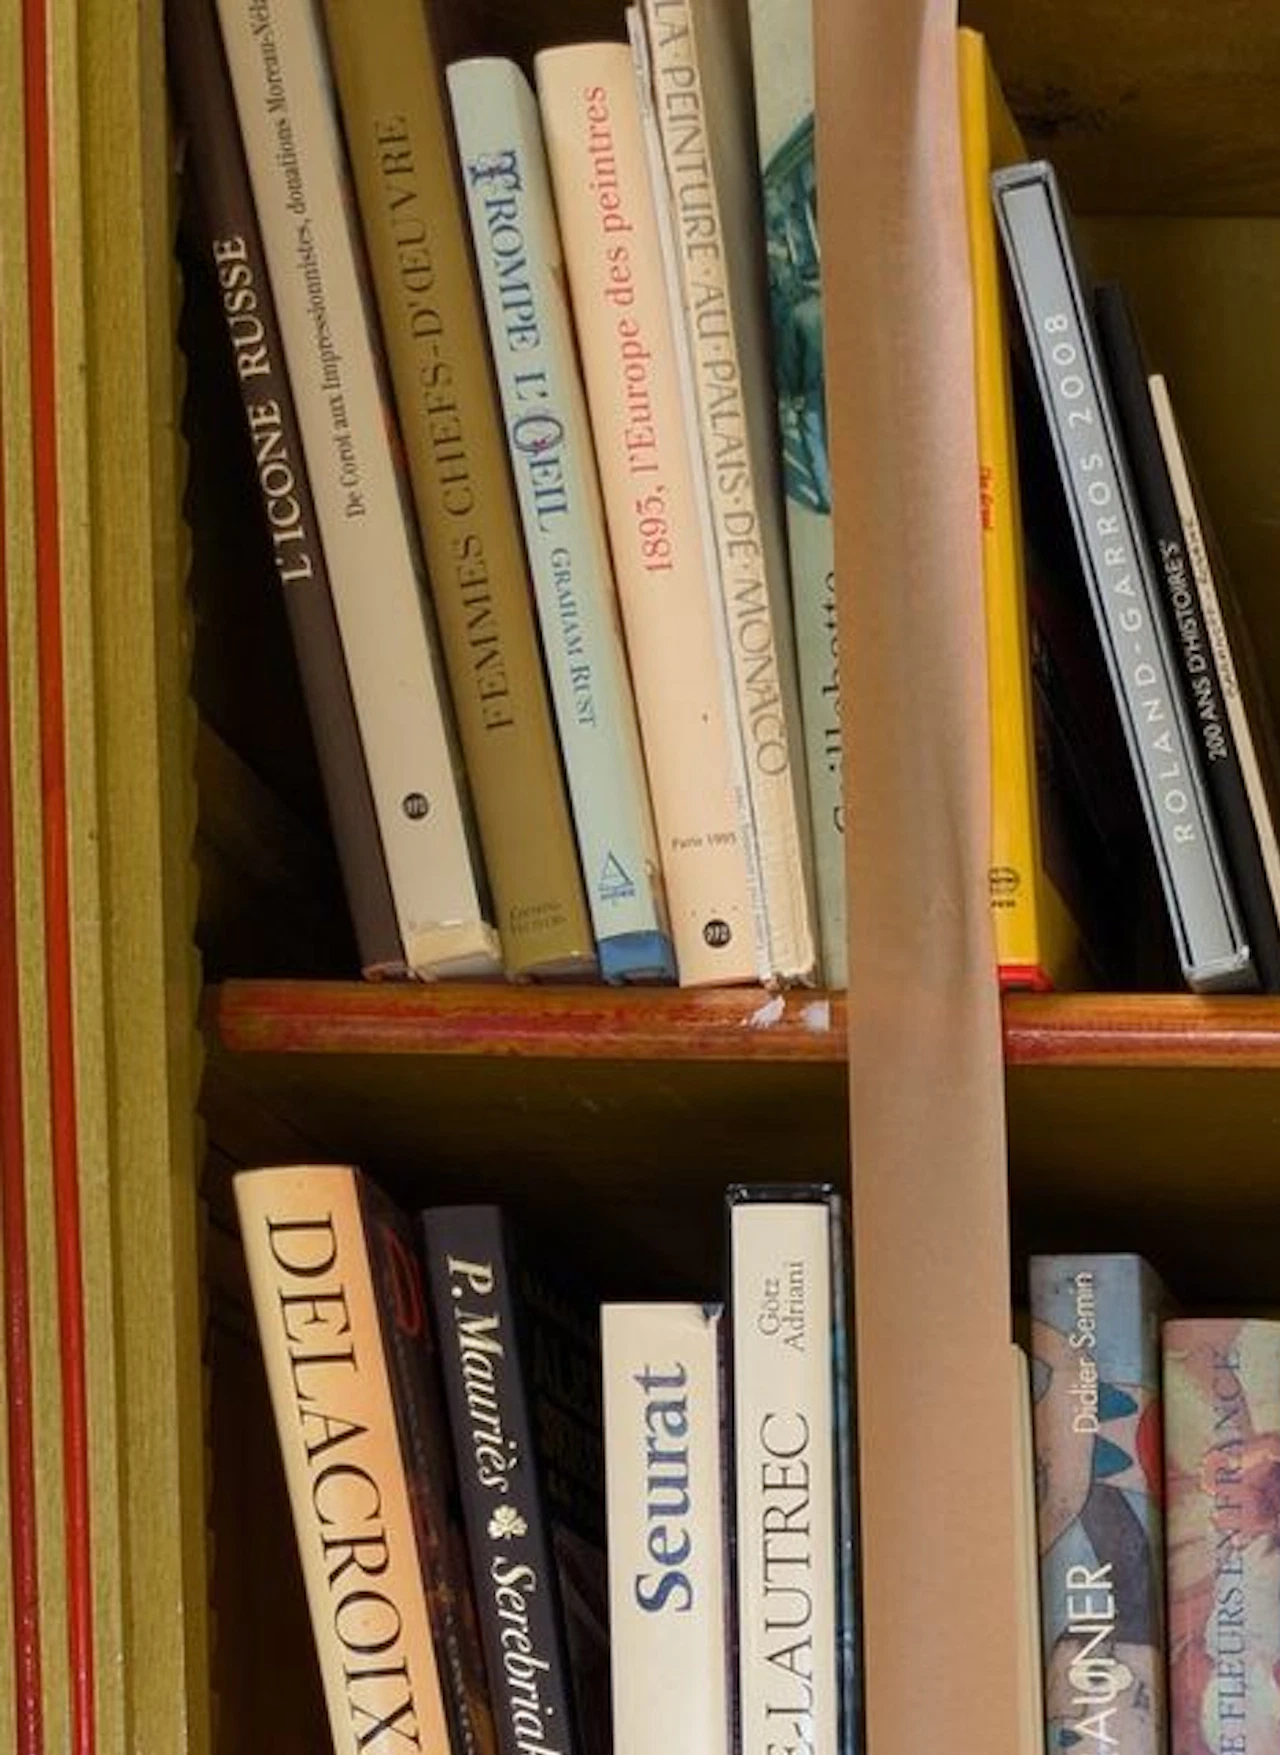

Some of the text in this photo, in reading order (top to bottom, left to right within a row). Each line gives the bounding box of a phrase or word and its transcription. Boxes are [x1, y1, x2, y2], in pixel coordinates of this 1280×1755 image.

[585, 86, 634, 236] peintres
[214, 236, 271, 381] RUSSE
[277, 118, 367, 520] De Corot Impressionnistes, donations
[469, 148, 596, 728] TROMPE GRAHAM RUST
[462, 533, 516, 733] FEMMES
[453, 1307, 520, 1495] Mauriès
[784, 1259, 806, 1353] Adriani
[1070, 1271, 1098, 1433] Didier Semin
[265, 1211, 424, 1755] DELACROIX
[633, 1360, 693, 1615] Seurat
